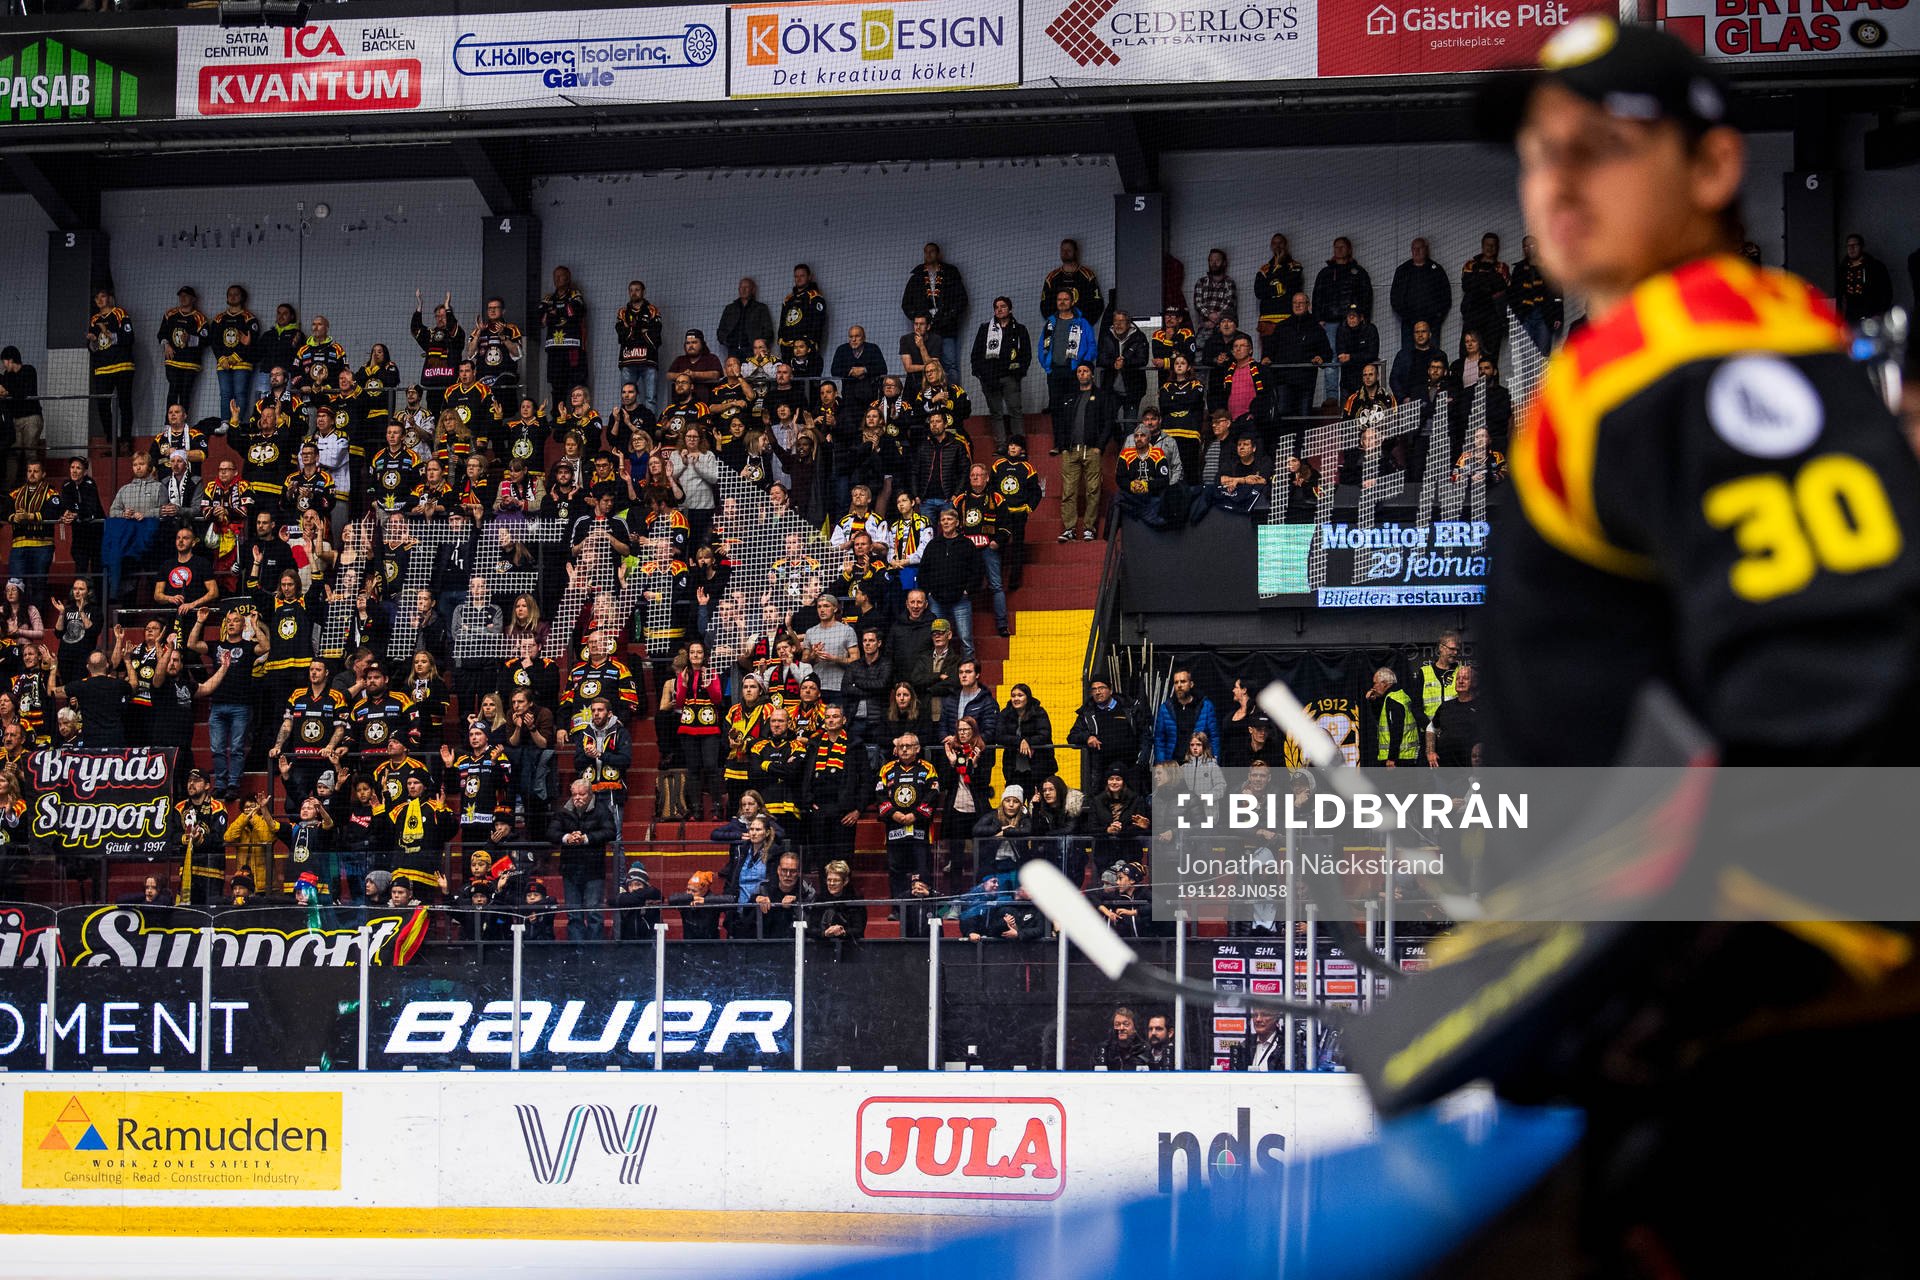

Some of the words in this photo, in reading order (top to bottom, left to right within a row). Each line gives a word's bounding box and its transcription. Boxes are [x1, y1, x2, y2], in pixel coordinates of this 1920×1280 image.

[1110, 4, 1298, 35] CEDERLÖFS
[1403, 6, 1510, 31] Gästrike
[1518, 2, 1569, 27] Plåt
[362, 27, 404, 40] FJÄLL-
[751, 16, 1004, 57] KÖKSDESIGN
[1112, 33, 1266, 47] PLATTSÄTTNING
[1273, 32, 1298, 42] AB
[1715, 14, 1841, 55] GLAS
[284, 25, 346, 59] ICA
[362, 40, 415, 52] BACKEN
[1430, 36, 1506, 50] gastrikeplat.se
[204, 46, 269, 58] CENTRUM
[543, 66, 615, 89] Gävle
[773, 69, 806, 86] Det
[817, 64, 902, 84] kreativa
[912, 61, 976, 80] köket!
[0, 75, 90, 108] PASAB
[209, 69, 410, 105] KVANTUM
[1806, 174, 1819, 190] 6
[1134, 196, 1146, 211] 5
[499, 218, 512, 233] 4
[65, 232, 76, 248] 3
[424, 367, 454, 377] GEVALIA
[1321, 522, 1430, 549] Monitor
[1433, 521, 1491, 547] ERP
[1702, 453, 1903, 604] 30
[1367, 551, 1402, 578] 29
[1403, 550, 1492, 583] februa
[1322, 590, 1391, 607] Biljetter:
[1317, 698, 1348, 711] 1912
[35, 748, 166, 792] Brynäs
[39, 794, 167, 840] Support
[105, 841, 131, 854] Gävle
[143, 841, 166, 852] 1997
[1218, 945, 1240, 955] SHL
[1254, 946, 1277, 956] SHL
[1405, 947, 1426, 955] SHL
[116, 1118, 328, 1151] Ramudden
[864, 1116, 1059, 1178] JULA
[92, 1159, 139, 1168] WORK
[152, 1159, 196, 1168] ZONE
[209, 1158, 273, 1168] SAFETY
[63, 1171, 122, 1184] Consulting
[132, 1172, 161, 1183] Road
[170, 1171, 243, 1183] Construction
[252, 1171, 300, 1185] Industry
